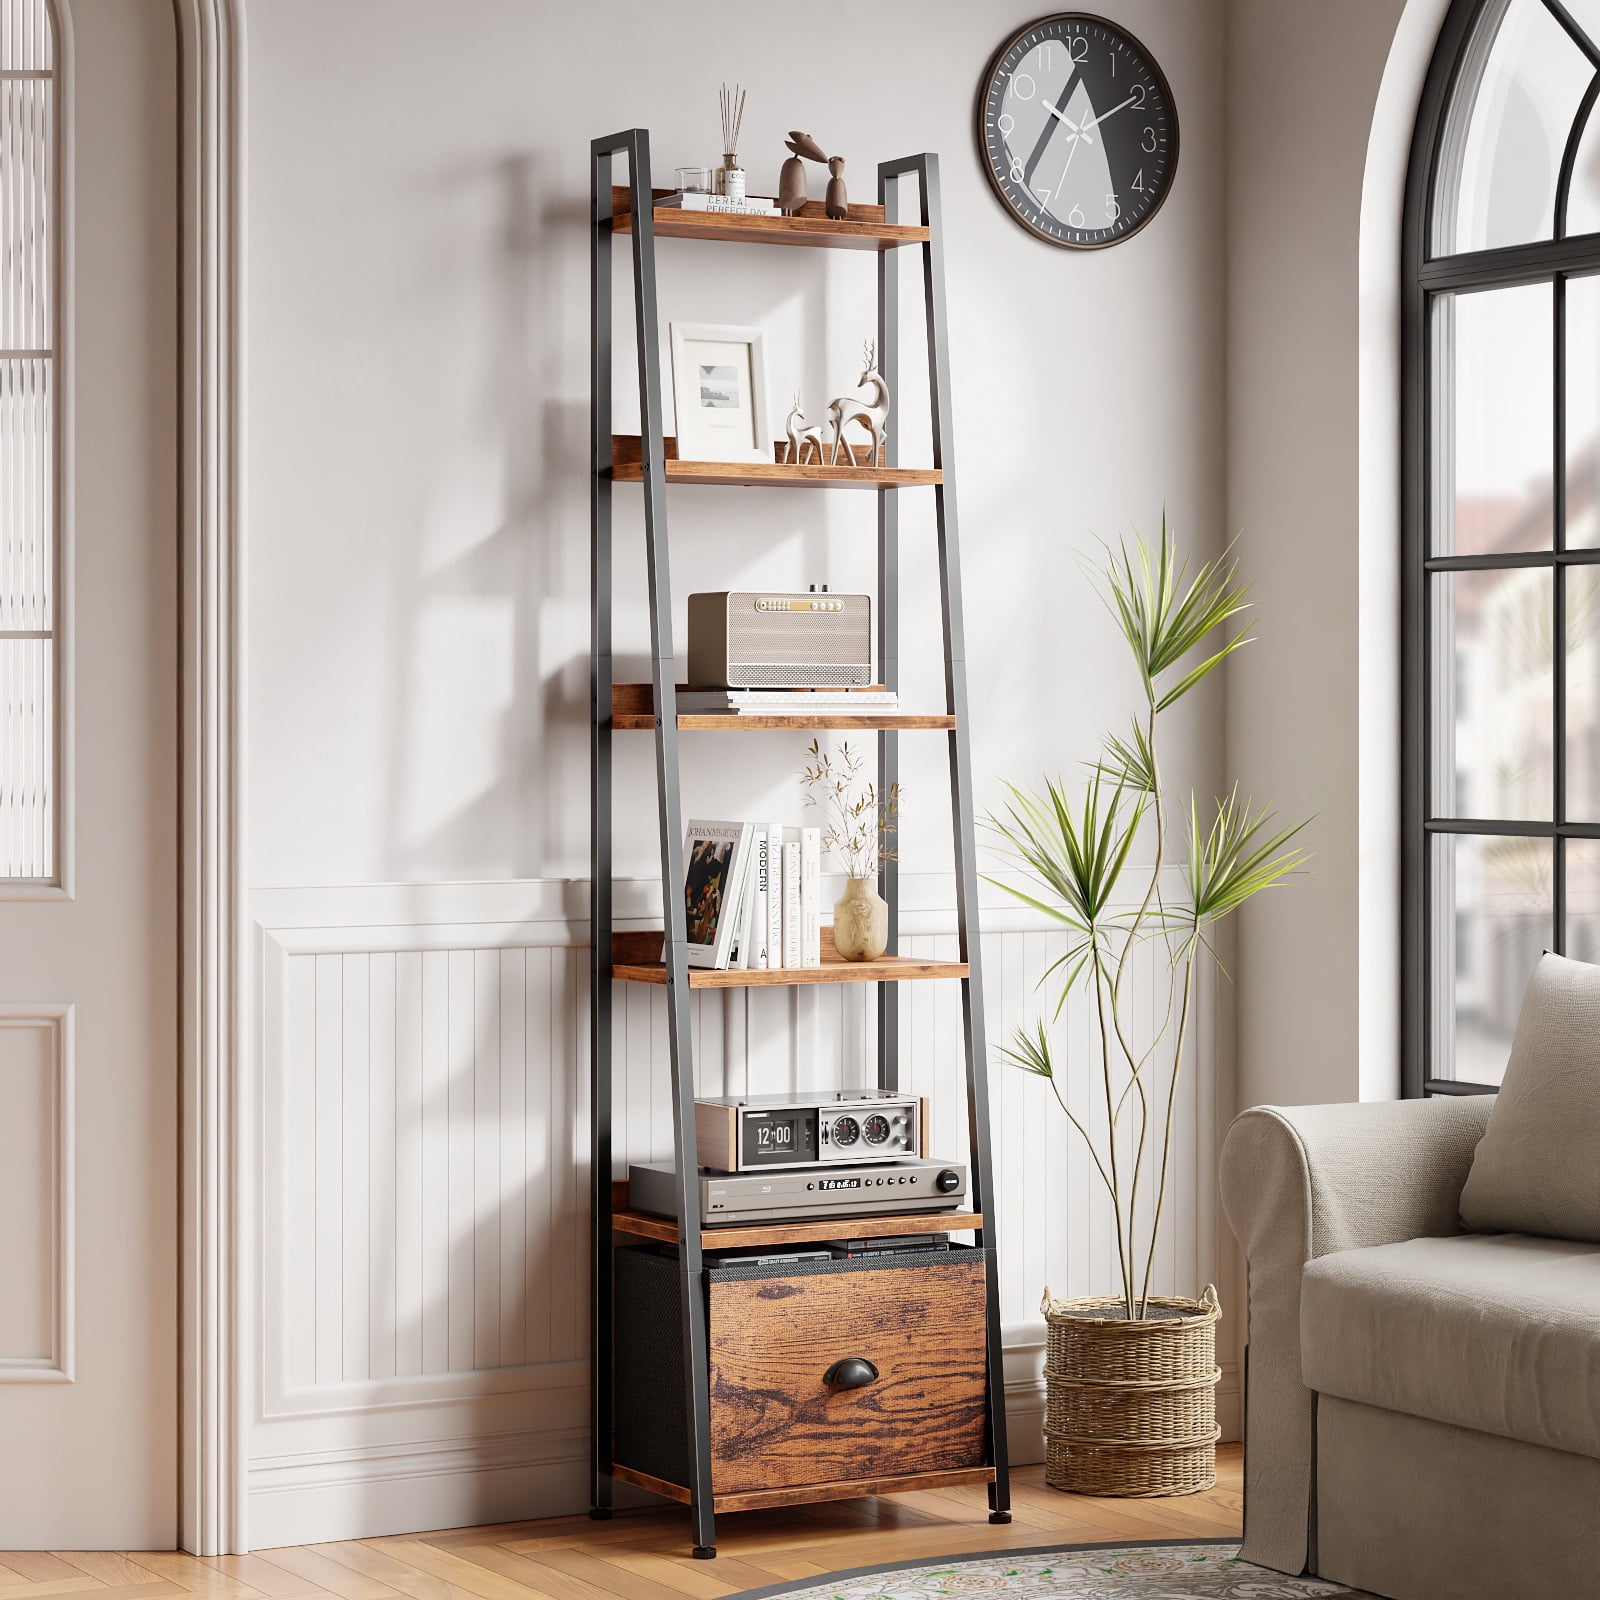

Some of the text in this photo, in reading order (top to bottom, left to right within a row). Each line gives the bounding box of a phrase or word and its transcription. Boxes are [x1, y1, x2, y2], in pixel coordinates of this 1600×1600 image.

[1036, 46, 1051, 72] 11
[1065, 36, 1089, 62] 12
[1109, 52, 1115, 78] 1
[1007, 73, 1036, 100] 10
[1129, 84, 1146, 110] 2
[998, 114, 1015, 142] 9
[1141, 127, 1157, 153] 3
[1009, 157, 1025, 183] 8
[1131, 168, 1145, 192] 4
[708, 195, 748, 206] CEREAL
[1037, 189, 1052, 214] 7
[1105, 194, 1120, 220] 5
[1068, 204, 1085, 228] 6
[759, 840, 767, 892] MODERN
